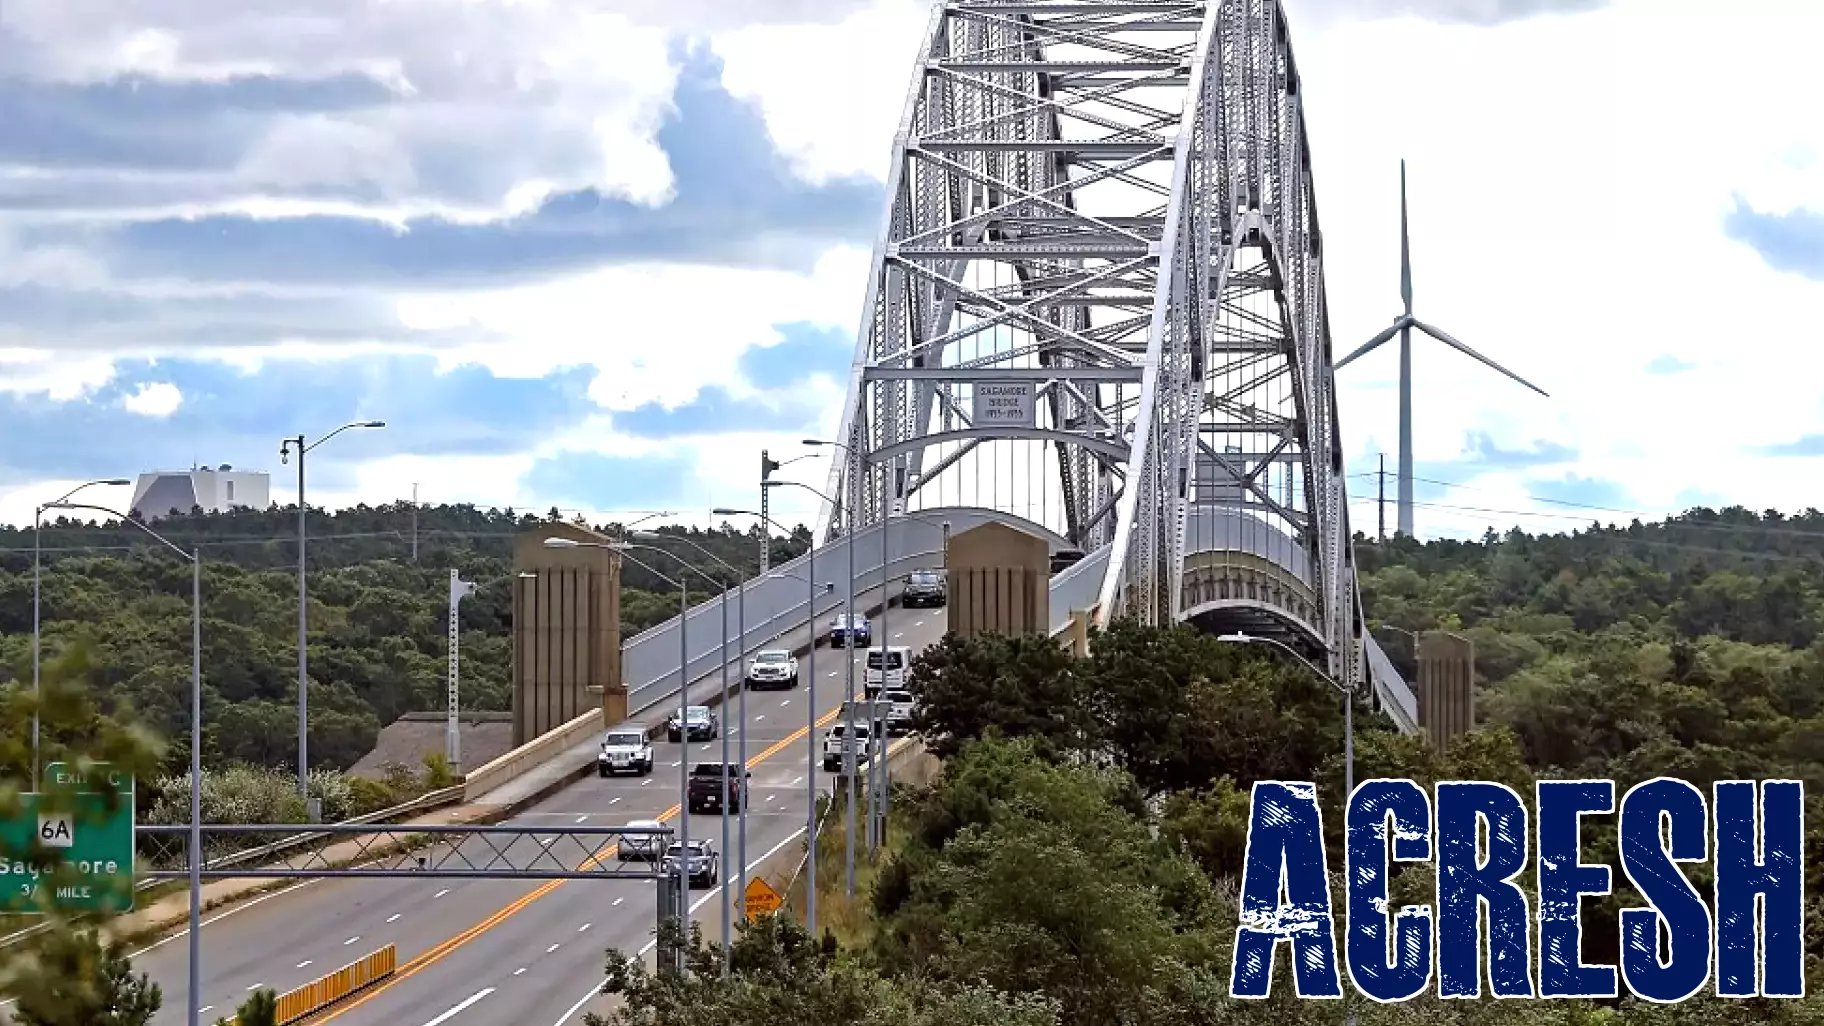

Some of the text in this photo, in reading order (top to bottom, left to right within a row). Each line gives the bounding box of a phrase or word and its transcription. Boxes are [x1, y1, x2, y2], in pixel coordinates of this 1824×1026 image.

[980, 386, 1027, 396] SAGAMORE
[988, 398, 1020, 407] BRIDGE
[41, 820, 70, 839] 6A
[0, 857, 118, 880] Sagaore
[56, 886, 92, 898] MILE
